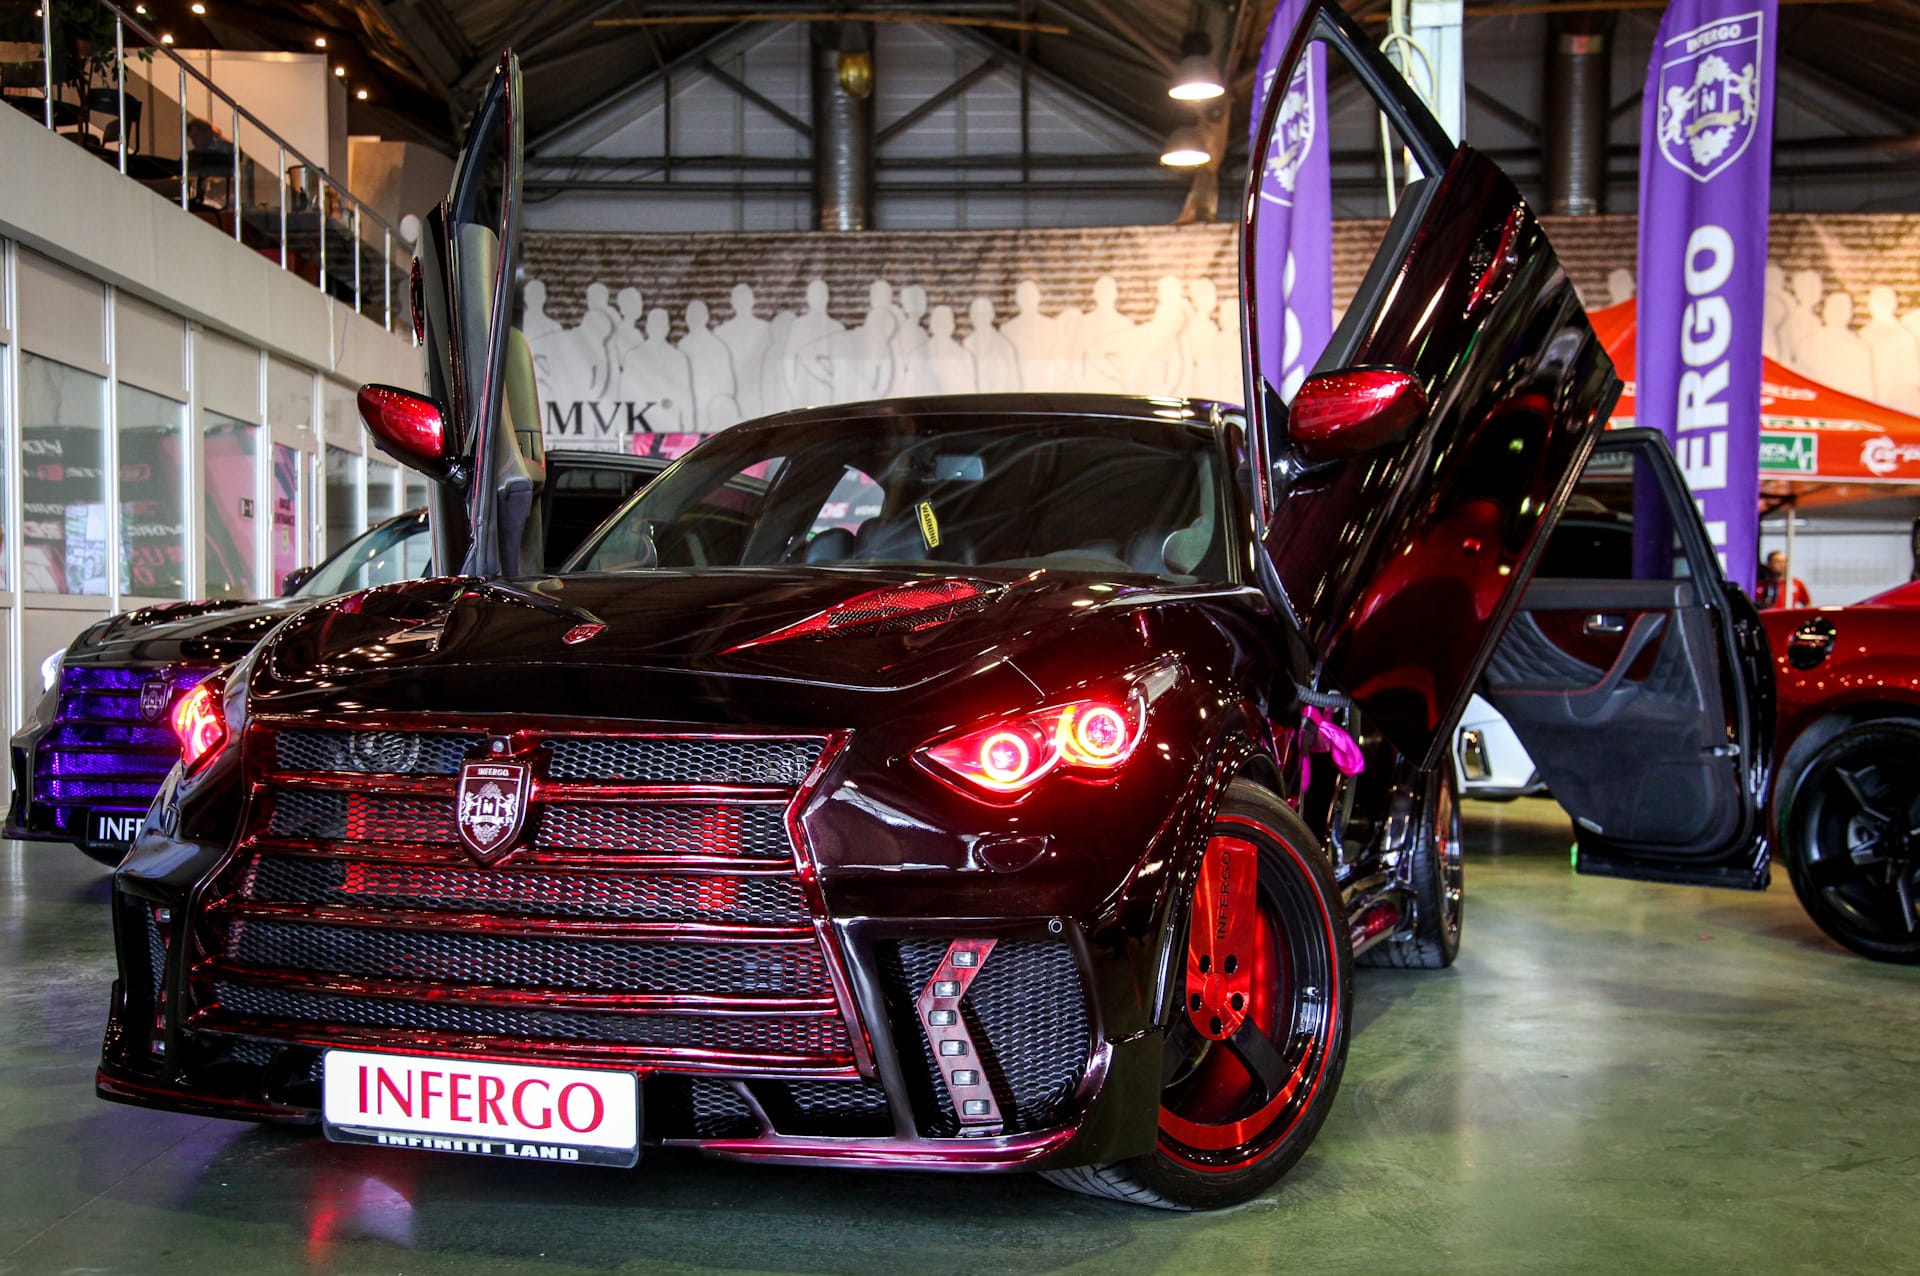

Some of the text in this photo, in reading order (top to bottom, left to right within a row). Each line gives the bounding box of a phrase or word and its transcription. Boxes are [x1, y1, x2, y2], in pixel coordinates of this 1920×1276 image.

[921, 504, 938, 545] WARNING
[477, 767, 510, 777] INFERGO
[1216, 851, 1231, 939] INFERGO
[358, 1065, 605, 1133] INFERGO
[377, 1134, 579, 1161] INFINITI LAND
